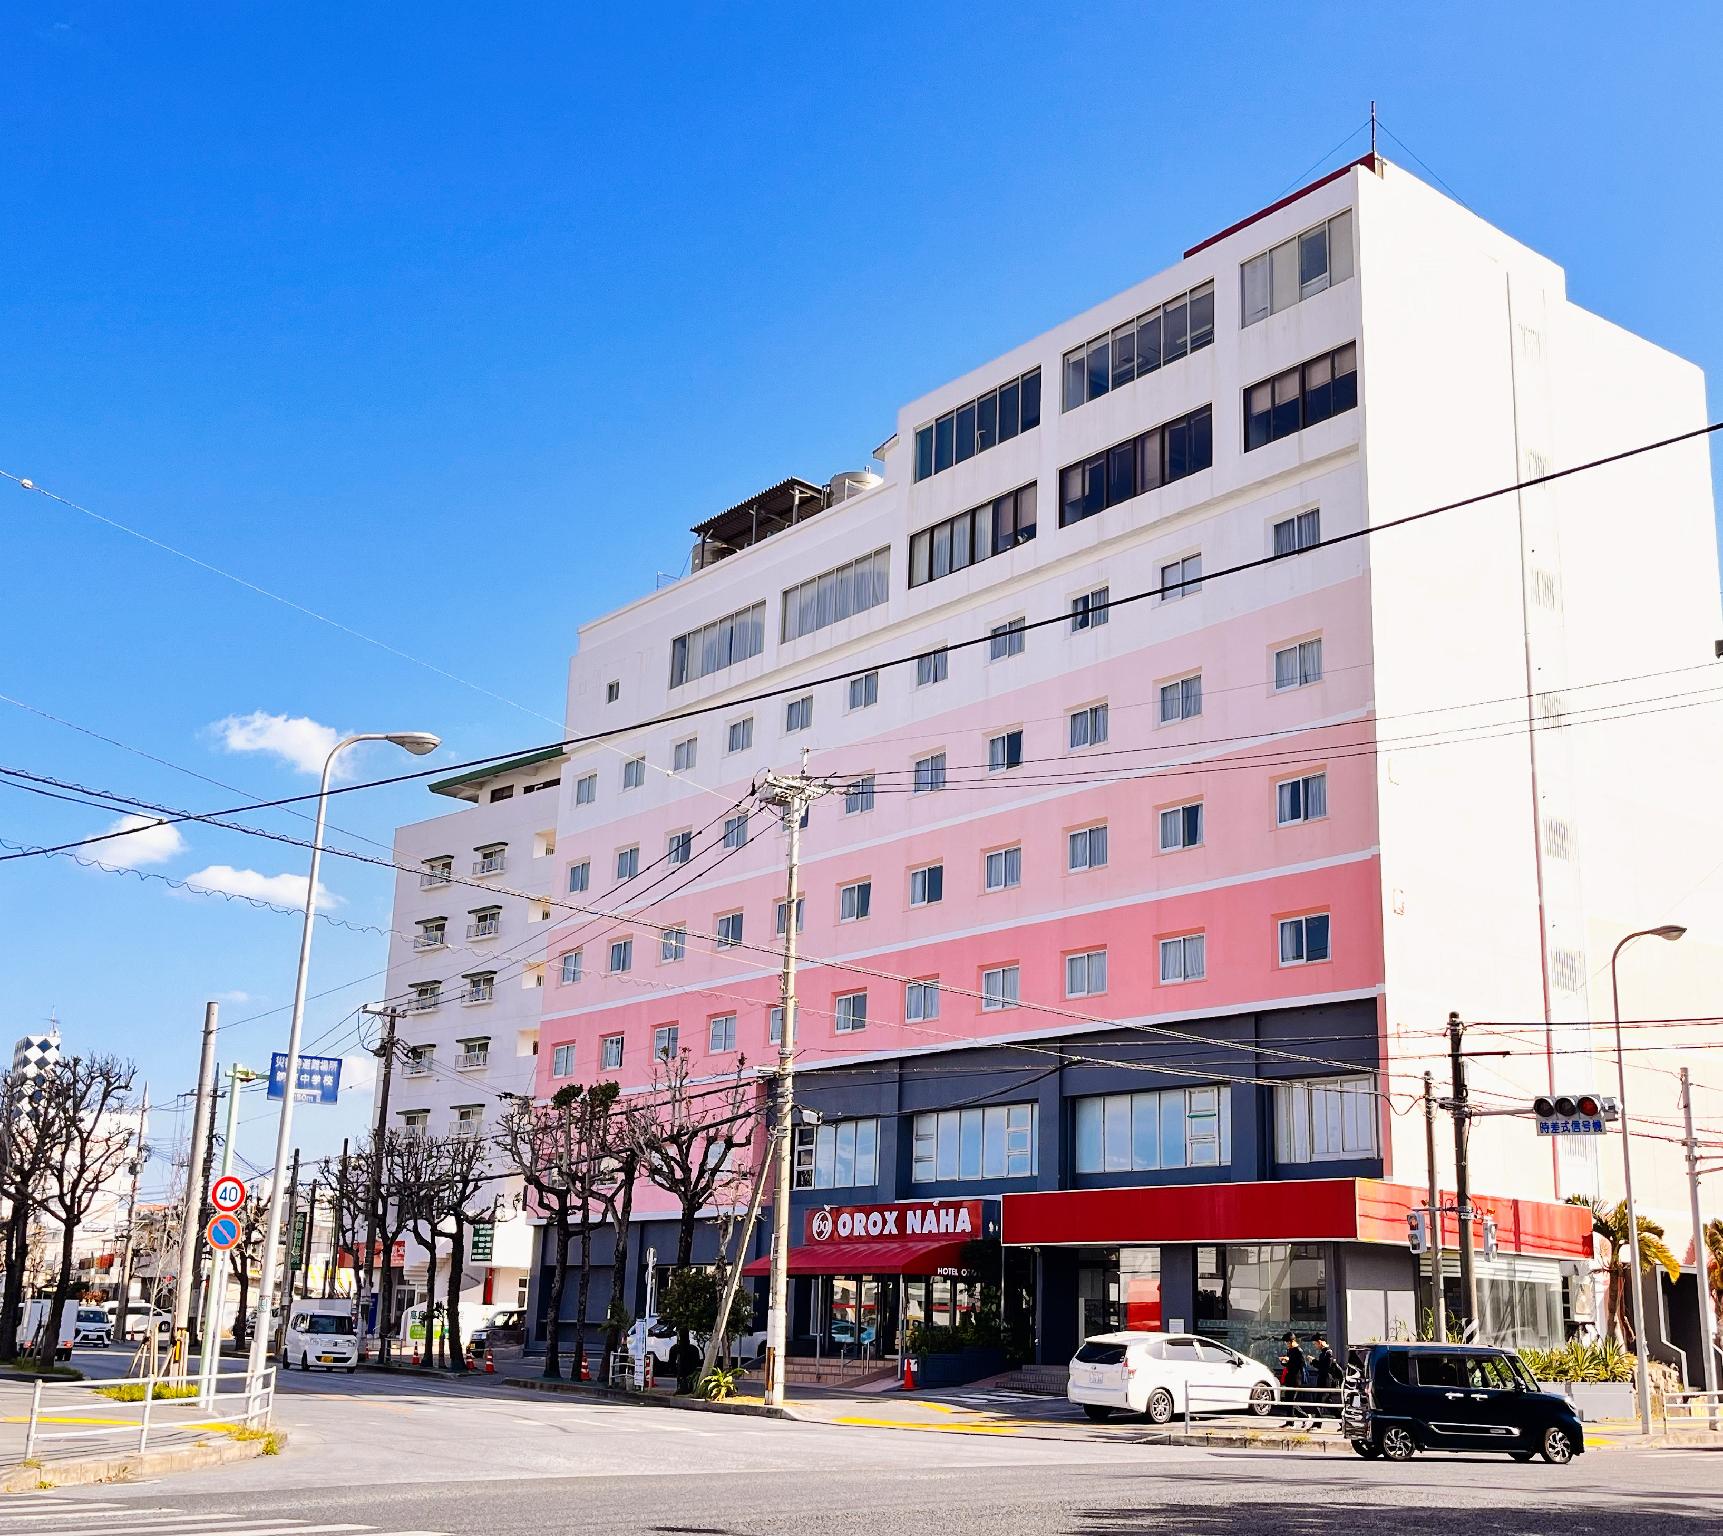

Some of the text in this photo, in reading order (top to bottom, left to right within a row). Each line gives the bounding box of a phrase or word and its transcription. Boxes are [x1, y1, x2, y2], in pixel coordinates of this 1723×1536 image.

[1539, 1120, 1603, 1134] 時差式信号機
[219, 1186, 238, 1202] 40
[837, 1211, 899, 1237] OROX
[906, 1208, 972, 1234] NAHA
[937, 1267, 959, 1276] HOTEL
